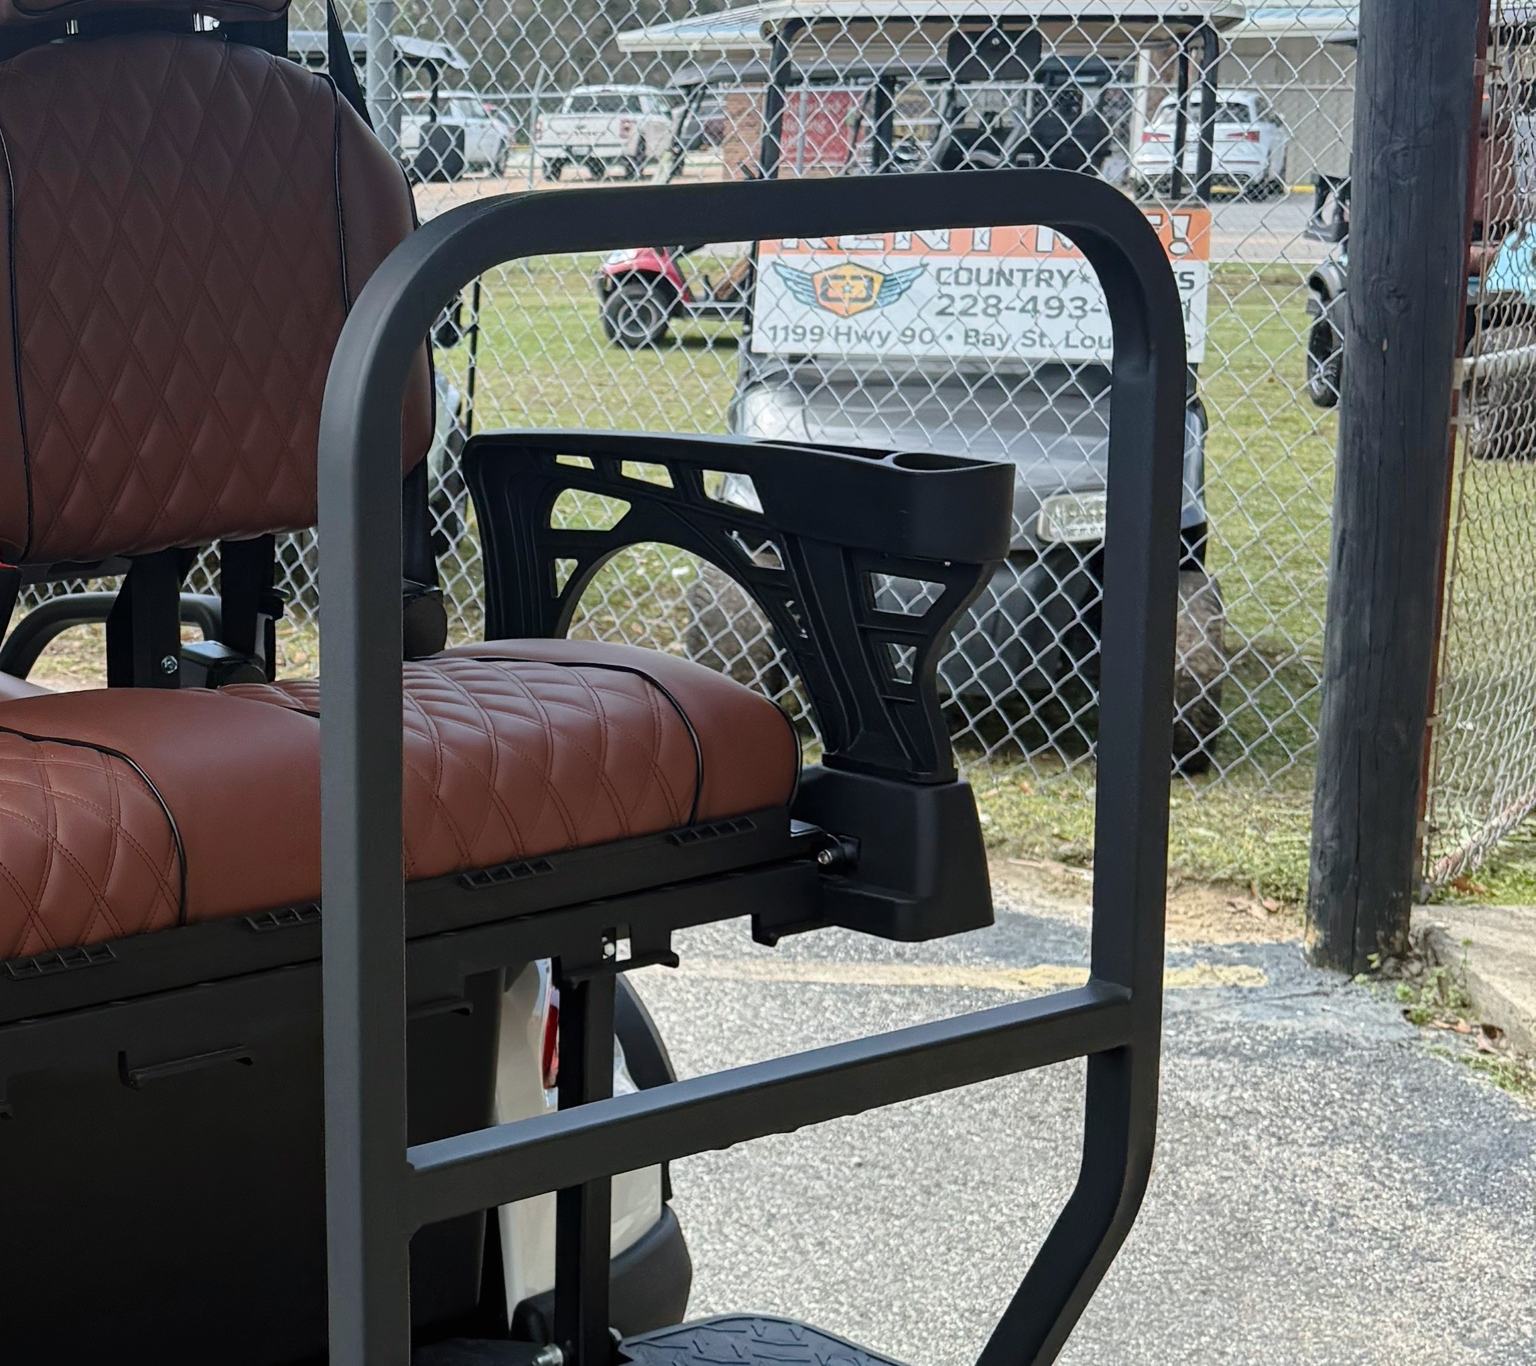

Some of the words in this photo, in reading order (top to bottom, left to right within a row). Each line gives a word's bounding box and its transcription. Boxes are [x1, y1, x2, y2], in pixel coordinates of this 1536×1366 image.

[935, 266, 1076, 288] COUNTRY
[768, 324, 825, 344] 1199
[834, 325, 892, 349] Hwy
[900, 326, 935, 345] 90
[964, 328, 1012, 351] Bay
[1021, 329, 1054, 349] St.
